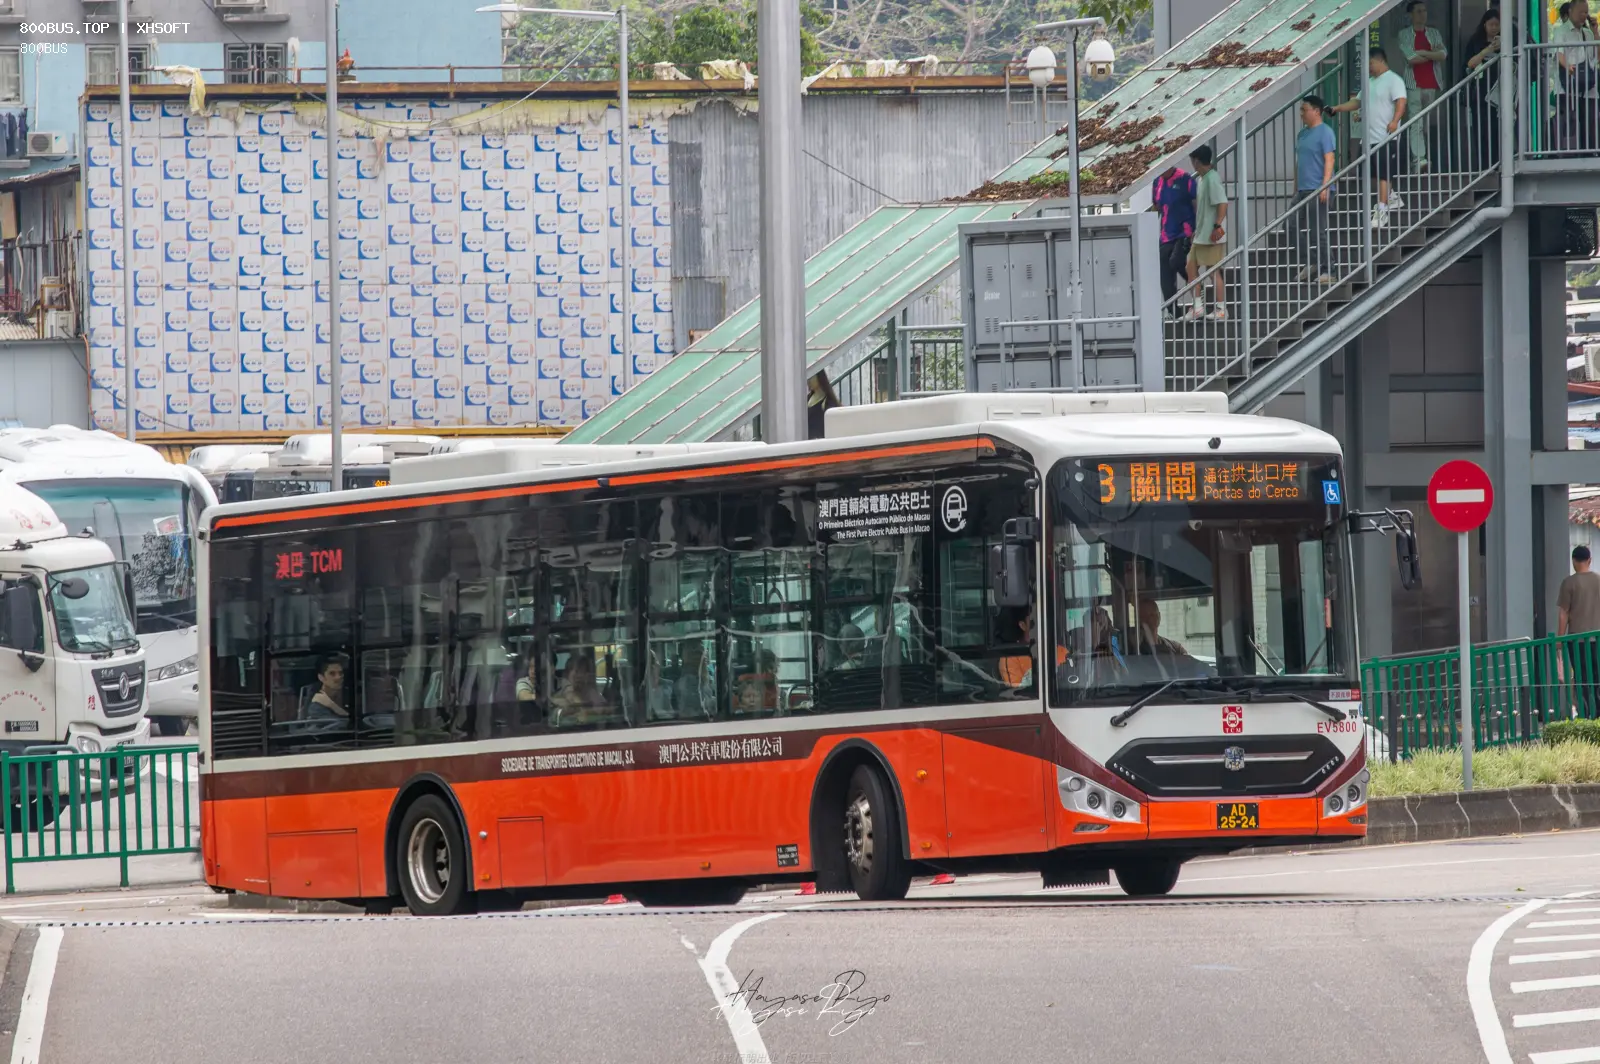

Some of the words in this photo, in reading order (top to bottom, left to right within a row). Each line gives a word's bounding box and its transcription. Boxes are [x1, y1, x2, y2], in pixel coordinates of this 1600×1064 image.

[1098, 463, 1116, 503] 3
[1130, 462, 1197, 502] 關閘
[1204, 485, 1243, 500] Portas
[1248, 485, 1261, 499] do
[1265, 484, 1299, 499] Cerco
[819, 490, 931, 518] 澳門首輛純電動公共巴士
[865, 516, 889, 526] Autocarro
[907, 513, 914, 522] de
[837, 531, 846, 540] The
[846, 530, 857, 539] First
[857, 529, 868, 538] Pure
[869, 527, 885, 537] Electric
[885, 526, 899, 535] Public
[900, 525, 909, 534] Bus
[310, 548, 343, 574] TCM
[1317, 720, 1357, 733] EV5800
[659, 736, 783, 764] 澳門公共汽車股份有限公司
[501, 757, 528, 773] SOCIEDADE
[528, 755, 535, 770] DE
[535, 753, 567, 770] TRANSPORTES
[568, 752, 597, 768] COLECTIVOS
[597, 751, 604, 766] DE
[1230, 803, 1246, 816] AD
[1220, 815, 1257, 829] 25-24
